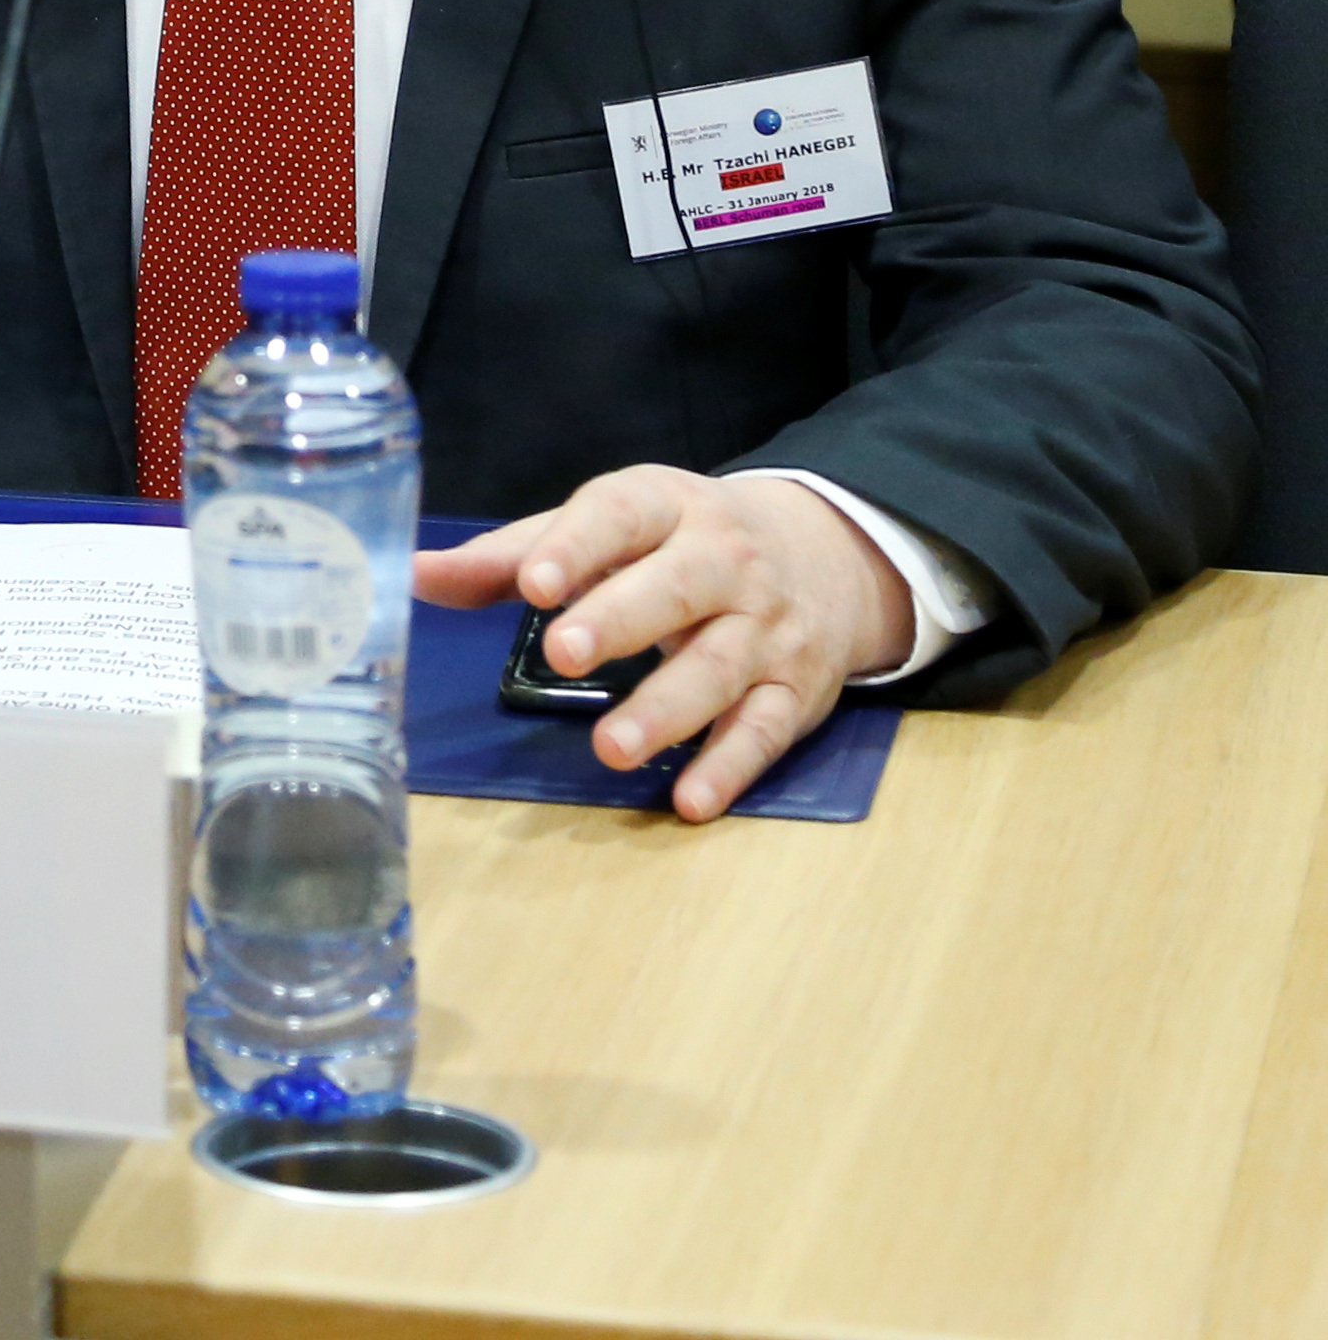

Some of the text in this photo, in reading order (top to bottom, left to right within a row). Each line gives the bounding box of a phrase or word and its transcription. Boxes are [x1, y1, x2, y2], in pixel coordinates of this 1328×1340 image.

[665, 127, 698, 138] orwegian
[682, 163, 704, 177] Mr
[713, 149, 770, 171] Tzachi
[775, 135, 857, 160] HANEGBI
[721, 166, 784, 189] ISRAEL
[679, 204, 713, 218] AHLC
[727, 198, 744, 210] 31
[748, 190, 799, 207] January
[803, 183, 835, 197] 2018
[731, 205, 789, 223] Schuman
[9, 587, 54, 595] and
[61, 586, 137, 597] Policy
[114, 581, 154, 590] His
[6, 594, 185, 610] Commissioner
[83, 613, 199, 627] reenblatt;
[14, 629, 107, 639] Special
[32, 655, 80, 663] and
[89, 657, 173, 671] Affairs
[62, 665, 134, 677] Union
[58, 692, 103, 702] Her
